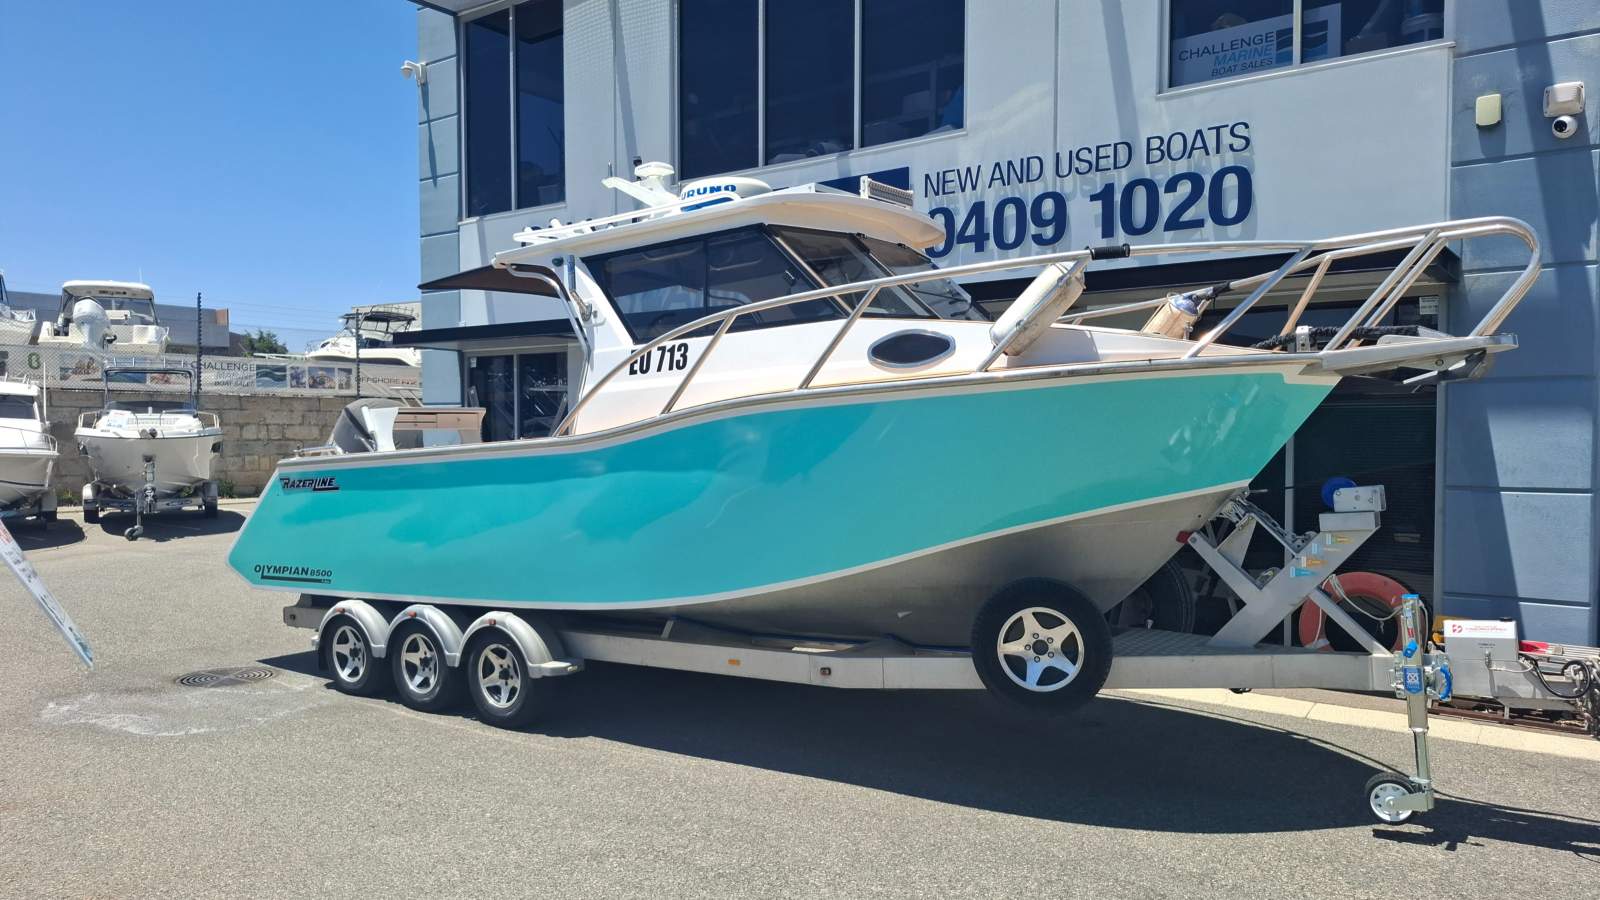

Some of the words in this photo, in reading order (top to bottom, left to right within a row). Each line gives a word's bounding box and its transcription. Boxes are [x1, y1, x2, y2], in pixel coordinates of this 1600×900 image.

[1178, 31, 1275, 62] CHALLENGE
[1213, 45, 1274, 67] MARINE
[1211, 63, 1239, 77] BOAT
[1240, 57, 1273, 71] SALES
[924, 164, 982, 198] NEW
[988, 155, 1044, 190] AND
[1055, 141, 1133, 178] USED
[1146, 121, 1251, 165] BOATS
[681, 184, 737, 200] URUNO
[924, 191, 1068, 259] 0409
[1089, 165, 1253, 239] 1020
[657, 342, 689, 373] 713
[254, 564, 309, 580] OLYMPIAN
[310, 569, 333, 577] 8500
